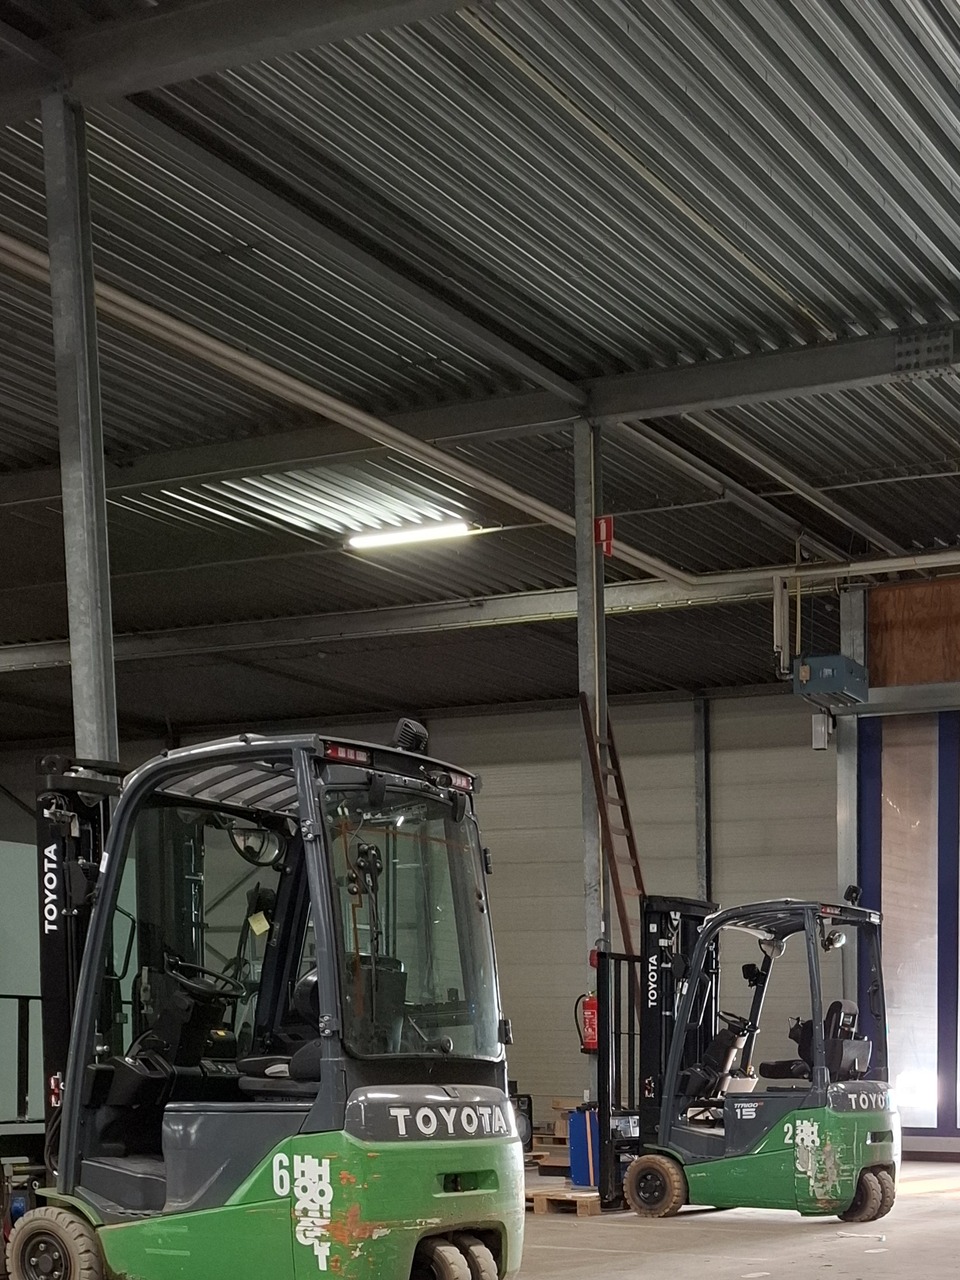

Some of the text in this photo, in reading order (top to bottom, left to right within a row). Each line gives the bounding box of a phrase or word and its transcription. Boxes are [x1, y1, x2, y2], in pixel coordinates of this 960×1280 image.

[44, 843, 58, 935] TOYOTA
[648, 955, 658, 1008] TOYOTA
[736, 1108, 756, 1119] 15
[848, 1091, 891, 1110] TOYO
[389, 1106, 509, 1137] TOYOTA
[784, 1123, 793, 1144] 2
[273, 1152, 290, 1196] 6
